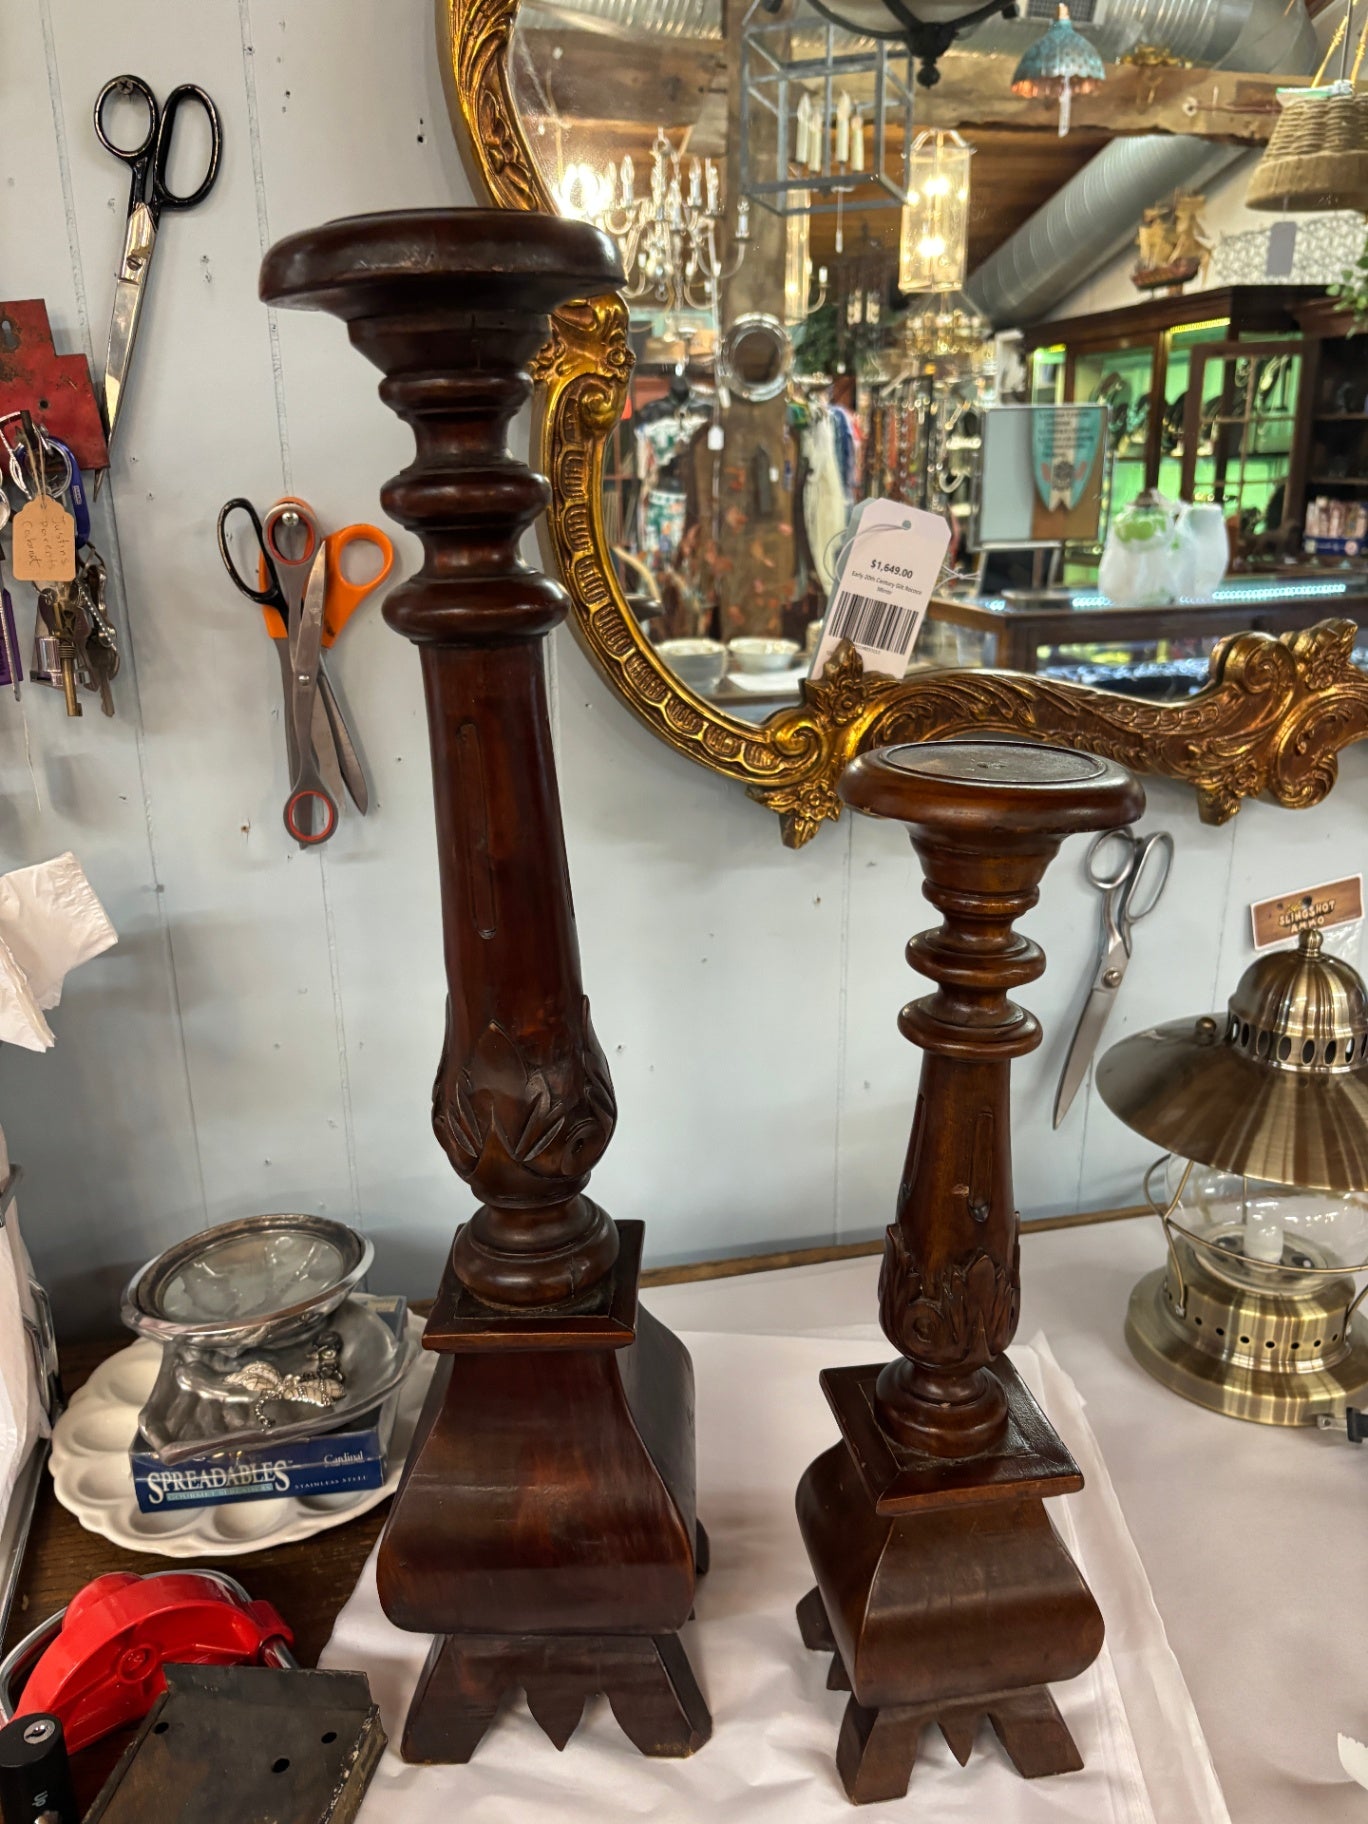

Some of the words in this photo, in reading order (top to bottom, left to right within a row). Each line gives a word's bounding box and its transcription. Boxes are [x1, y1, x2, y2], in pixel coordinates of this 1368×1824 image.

[852, 570, 863, 579] Early
[876, 578, 895, 588] Century
[871, 560, 913, 579] $1,649.00
[1280, 900, 1335, 926] SLINGSHOT
[1290, 915, 1325, 934] AMMO
[323, 1450, 364, 1464] Cardinal
[147, 1460, 290, 1504] SPREADABLES
[294, 1479, 340, 1490] STAINLESS
